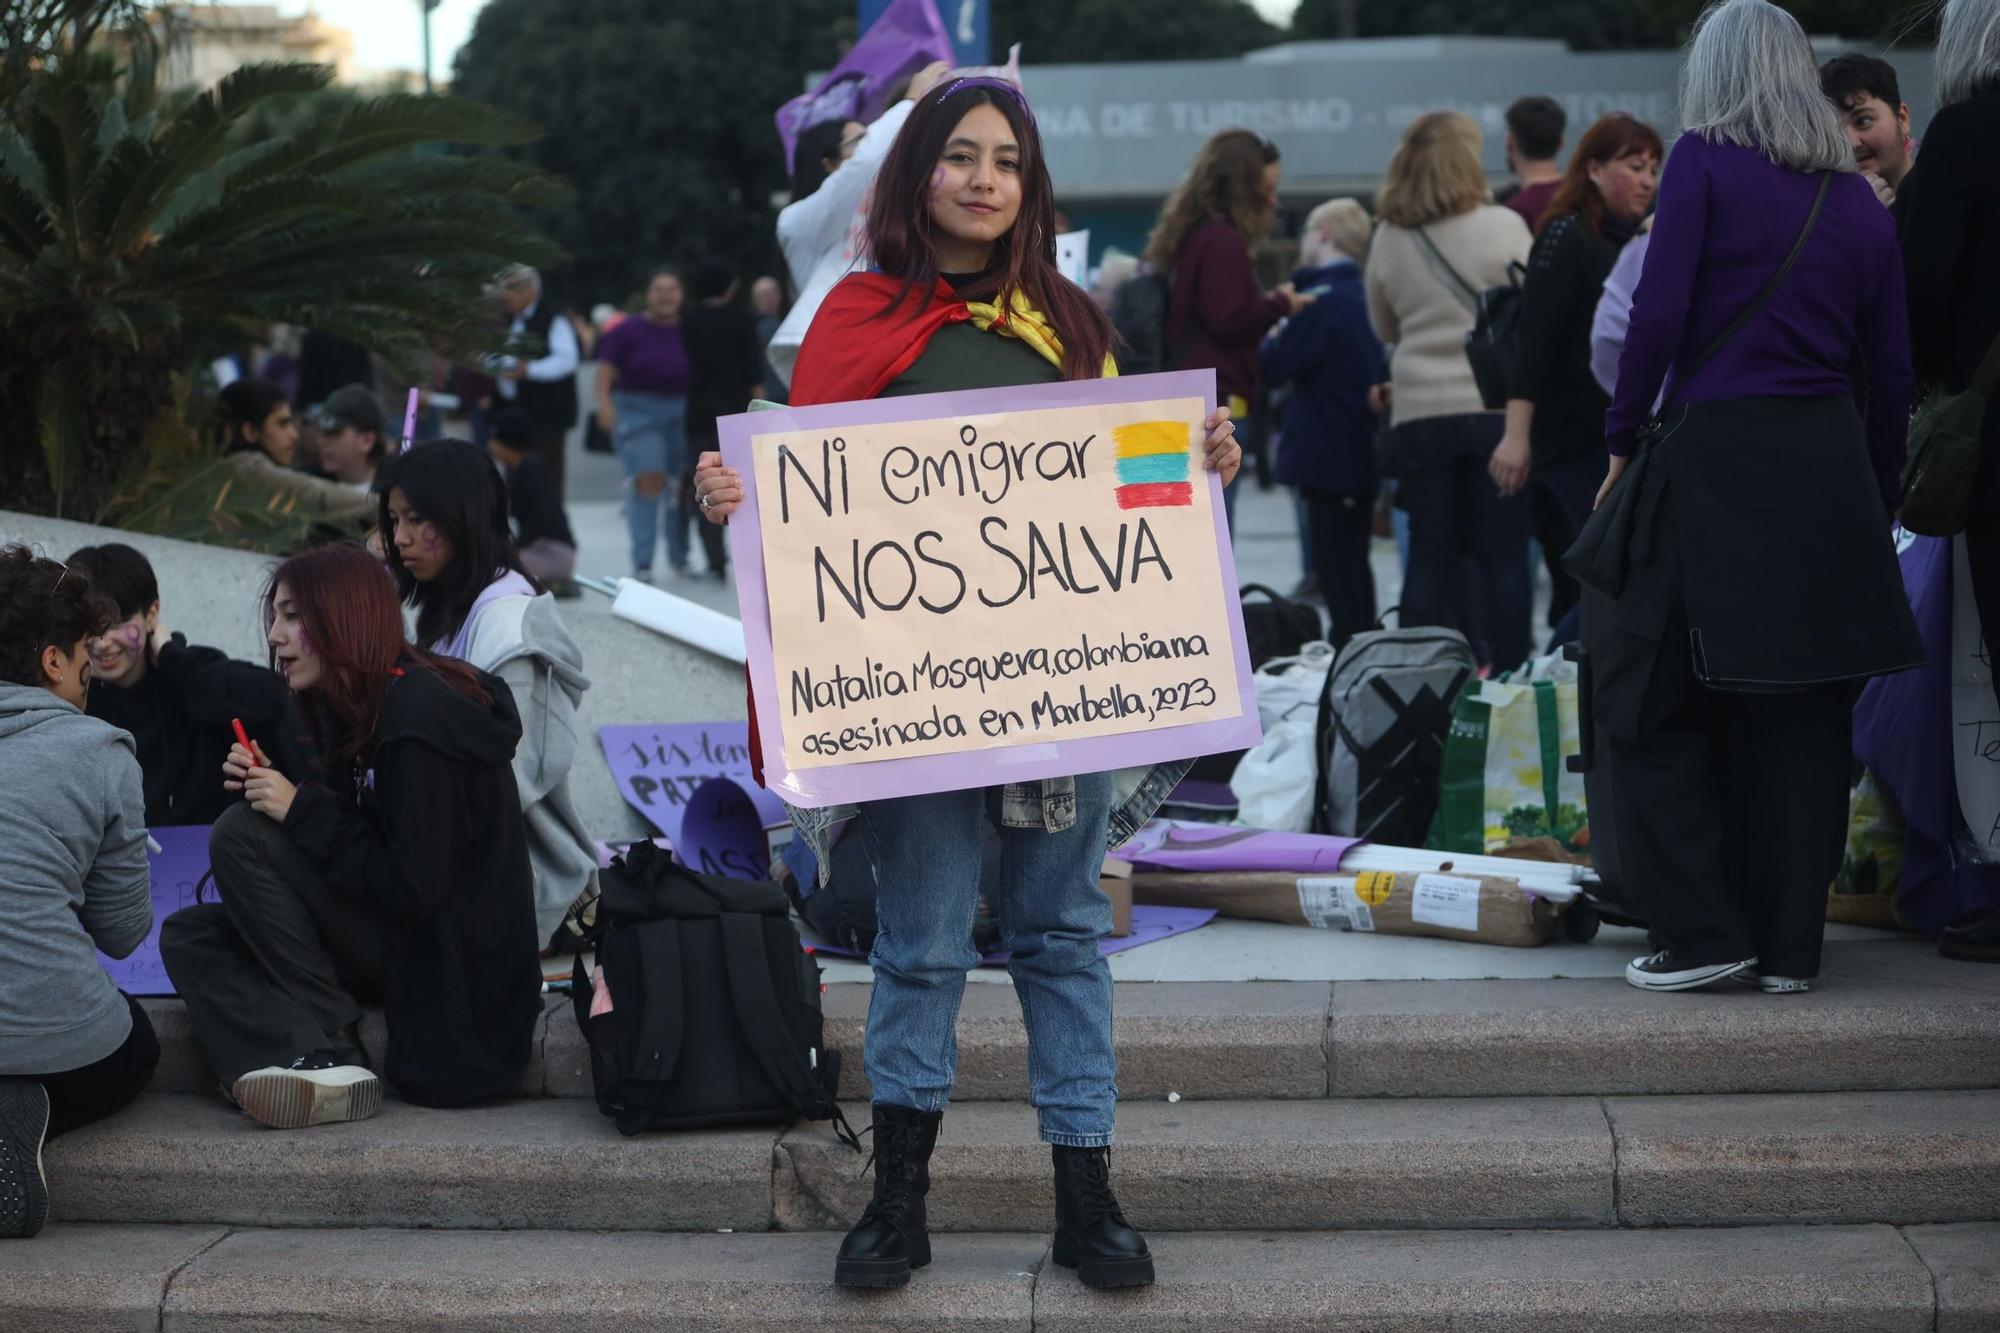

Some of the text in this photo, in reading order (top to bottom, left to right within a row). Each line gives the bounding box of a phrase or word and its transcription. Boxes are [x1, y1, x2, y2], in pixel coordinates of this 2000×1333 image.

[1101, 102, 1156, 137] DE
[1173, 98, 1352, 134] TURISMO
[778, 424, 1097, 524] Ni emigrar
[814, 516, 1173, 622] NOS SALVA
[792, 656, 909, 717] Natalia
[624, 731, 749, 768] sistem
[802, 704, 967, 756] asesinada
[979, 709, 1024, 737] en
